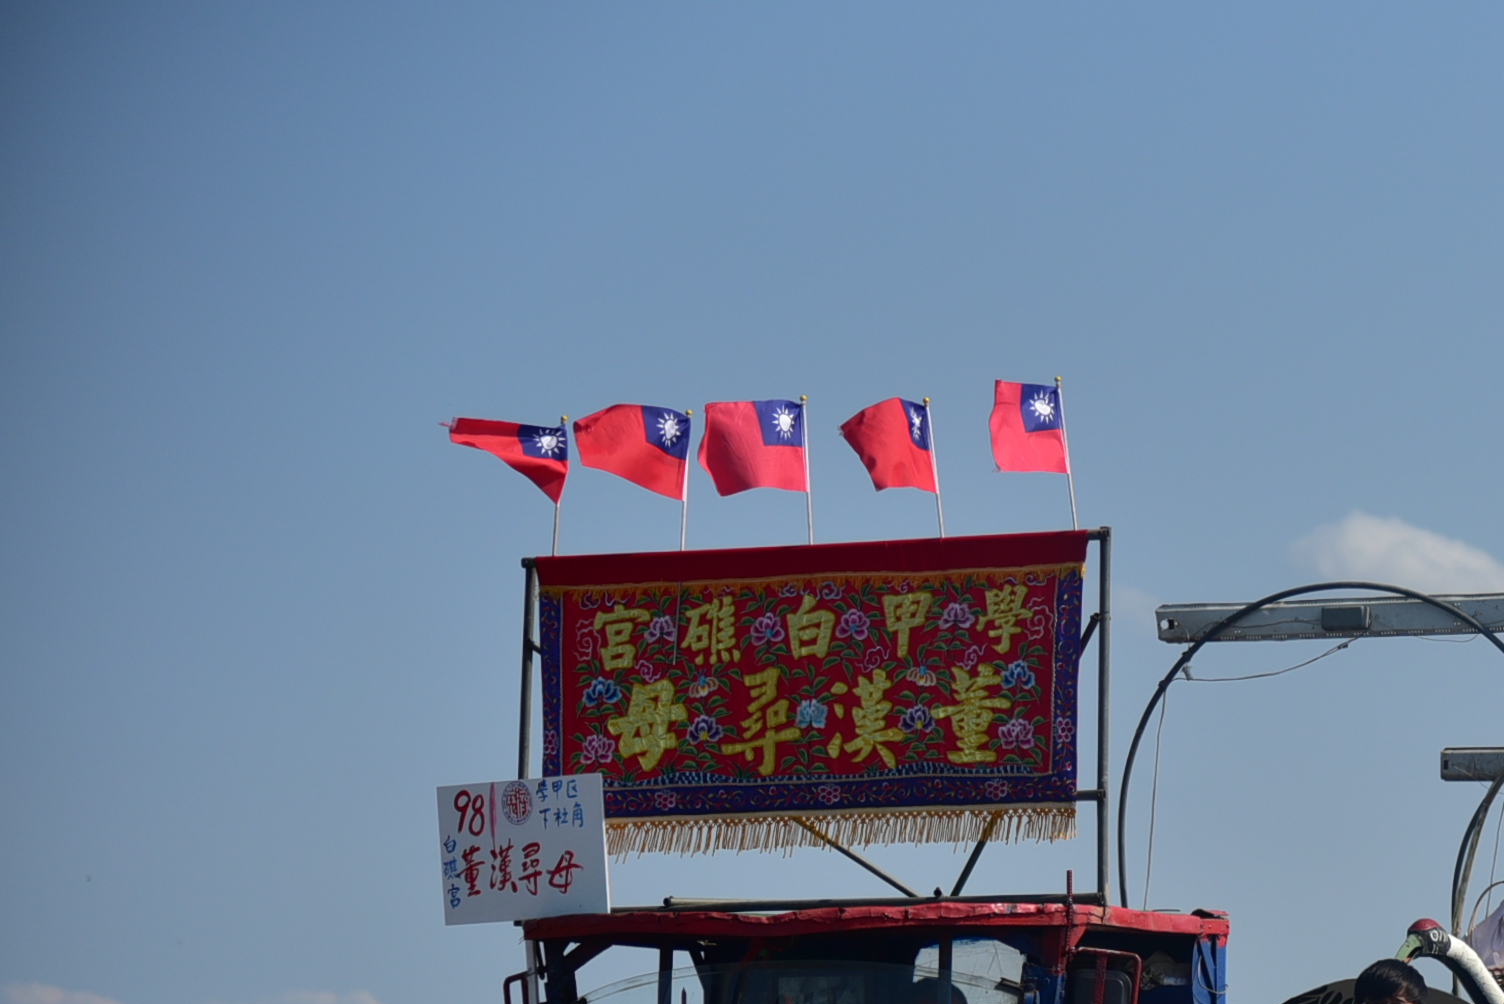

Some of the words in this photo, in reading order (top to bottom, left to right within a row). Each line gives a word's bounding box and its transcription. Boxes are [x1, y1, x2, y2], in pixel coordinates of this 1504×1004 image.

[594, 584, 1033, 671] 學甲白礁宮
[607, 663, 1012, 776] 董漢尋母
[458, 838, 584, 897] 董漢尋母
